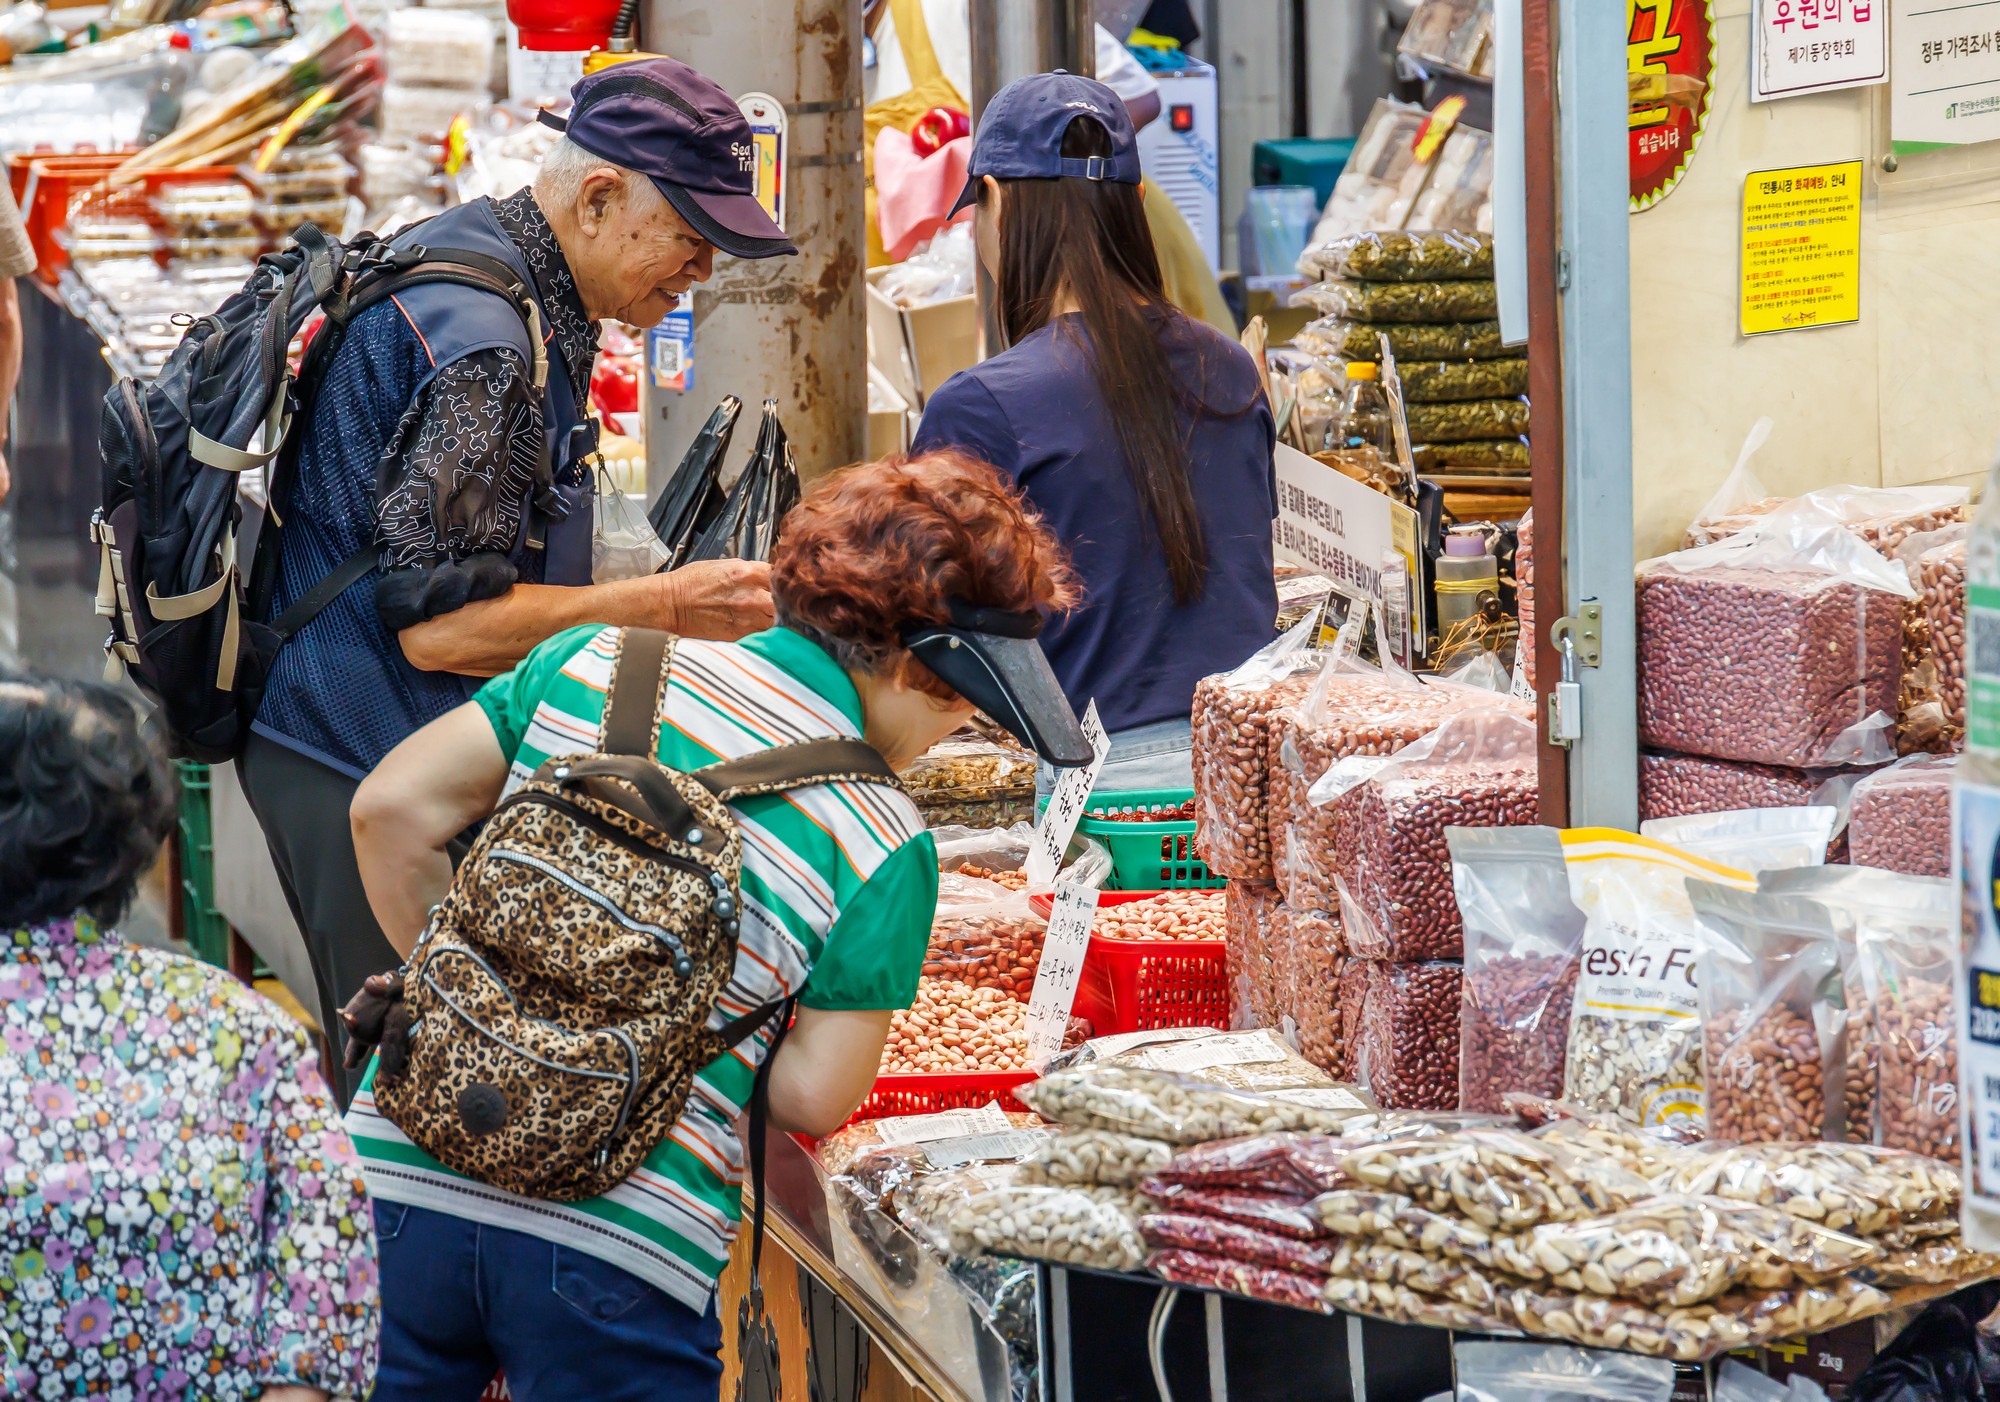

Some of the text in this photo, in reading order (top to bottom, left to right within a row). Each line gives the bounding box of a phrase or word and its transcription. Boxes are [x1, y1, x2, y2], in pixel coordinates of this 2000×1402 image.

[1788, 39, 1854, 63] 제기동장학회
[1921, 41, 1943, 63] 정부
[1947, 32, 1991, 58] 가격조사
[731, 141, 751, 156] Sea
[1639, 127, 1680, 155] 있습니다
[1831, 173, 1846, 187] 안내
[1321, 540, 1346, 580] 영수증을
[1048, 958, 1075, 991] 중국산
[1585, 946, 1651, 978] esh
[1596, 985, 1631, 997] Premium
[1633, 987, 1665, 1001] Quality
